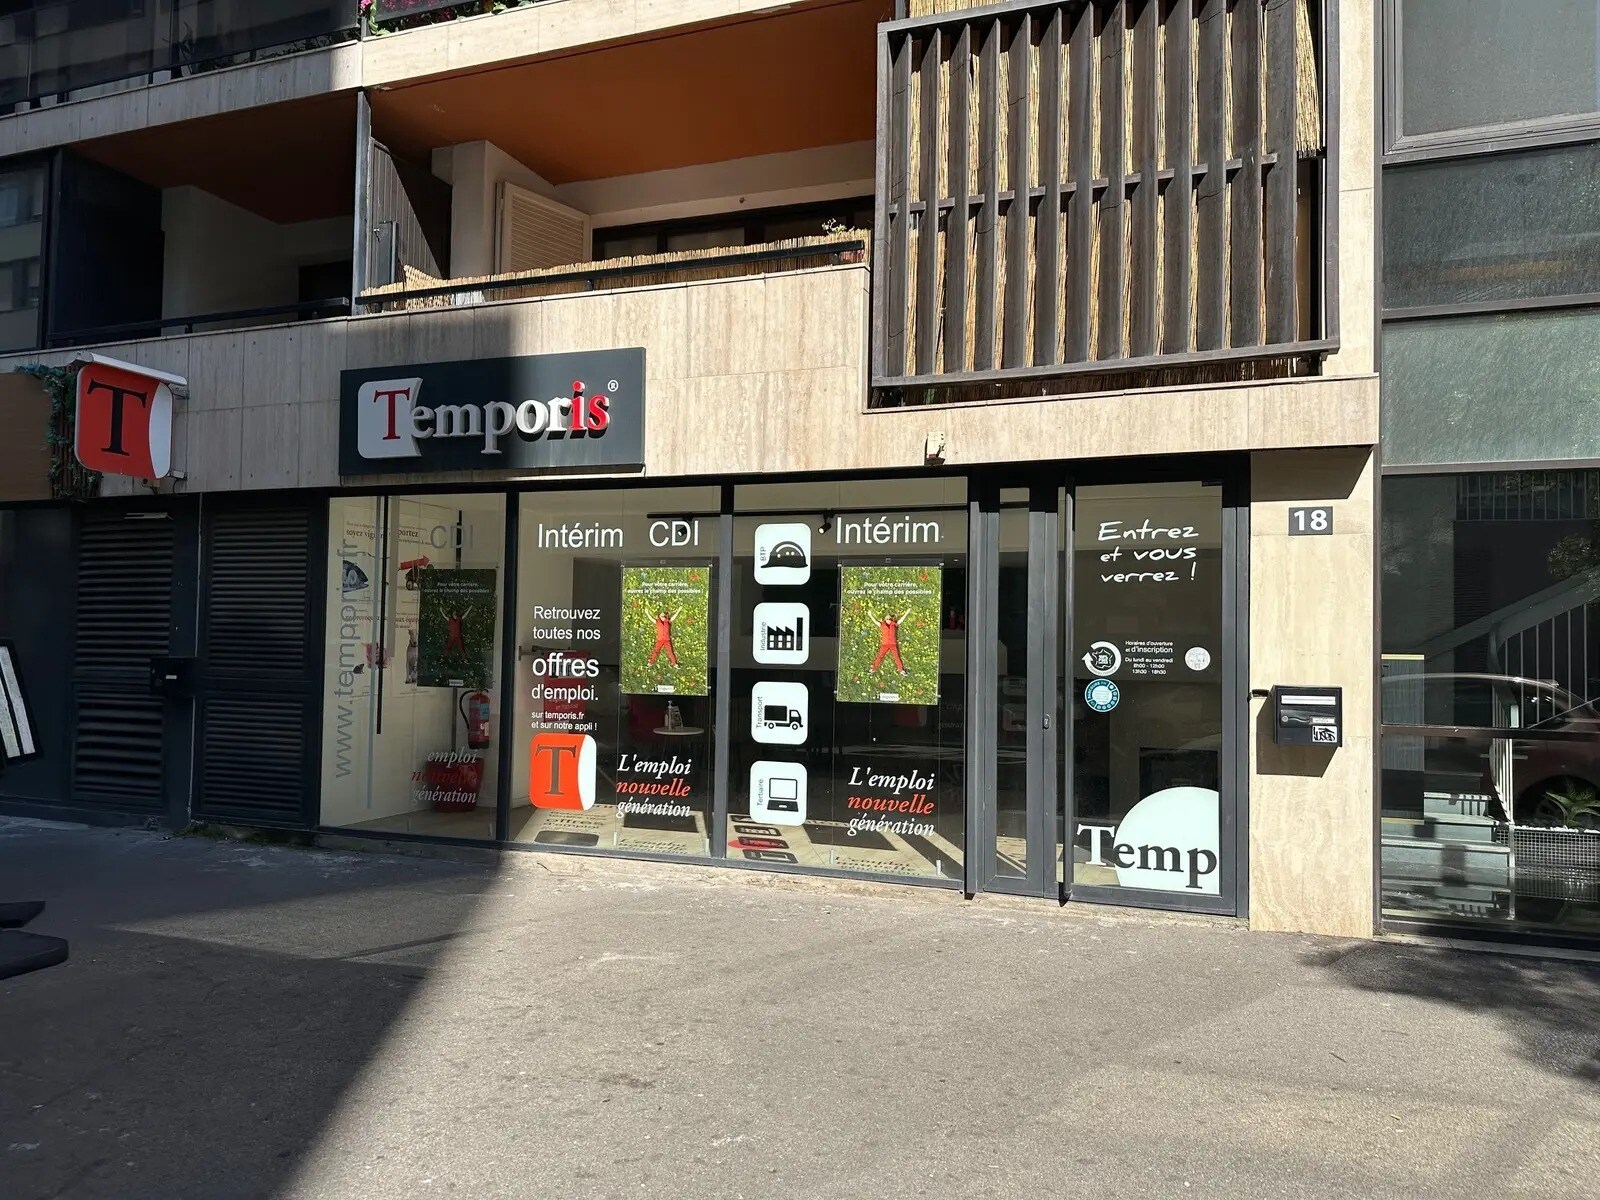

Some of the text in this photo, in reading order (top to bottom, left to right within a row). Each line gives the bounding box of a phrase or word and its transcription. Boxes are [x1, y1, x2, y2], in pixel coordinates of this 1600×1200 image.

[87, 378, 148, 456] T
[836, 515, 940, 544] Intérim
[1098, 518, 1199, 541] Entrez
[1293, 509, 1328, 531] 18
[538, 522, 624, 548] Intérim
[649, 520, 699, 547] CDI
[1100, 546, 1197, 562] et vous
[1101, 561, 1197, 582] verrez !
[533, 605, 601, 620] Retrouvez
[532, 626, 601, 640] toutes nos
[334, 539, 360, 778] www.tempor.fr
[532, 652, 600, 678] offres
[531, 683, 599, 704] d'emploi.
[531, 711, 585, 721] sur temporis.fr
[531, 721, 539, 729] et
[553, 722, 573, 730] notre
[574, 722, 593, 732] appli
[535, 744, 577, 796] T
[617, 753, 692, 780] L'emploi
[615, 778, 691, 797] nouvelle
[848, 766, 935, 795] L'emploi
[616, 796, 691, 819] génération
[847, 793, 935, 815] nouvelle
[847, 812, 935, 837] génération
[1076, 823, 1218, 890] Temp
